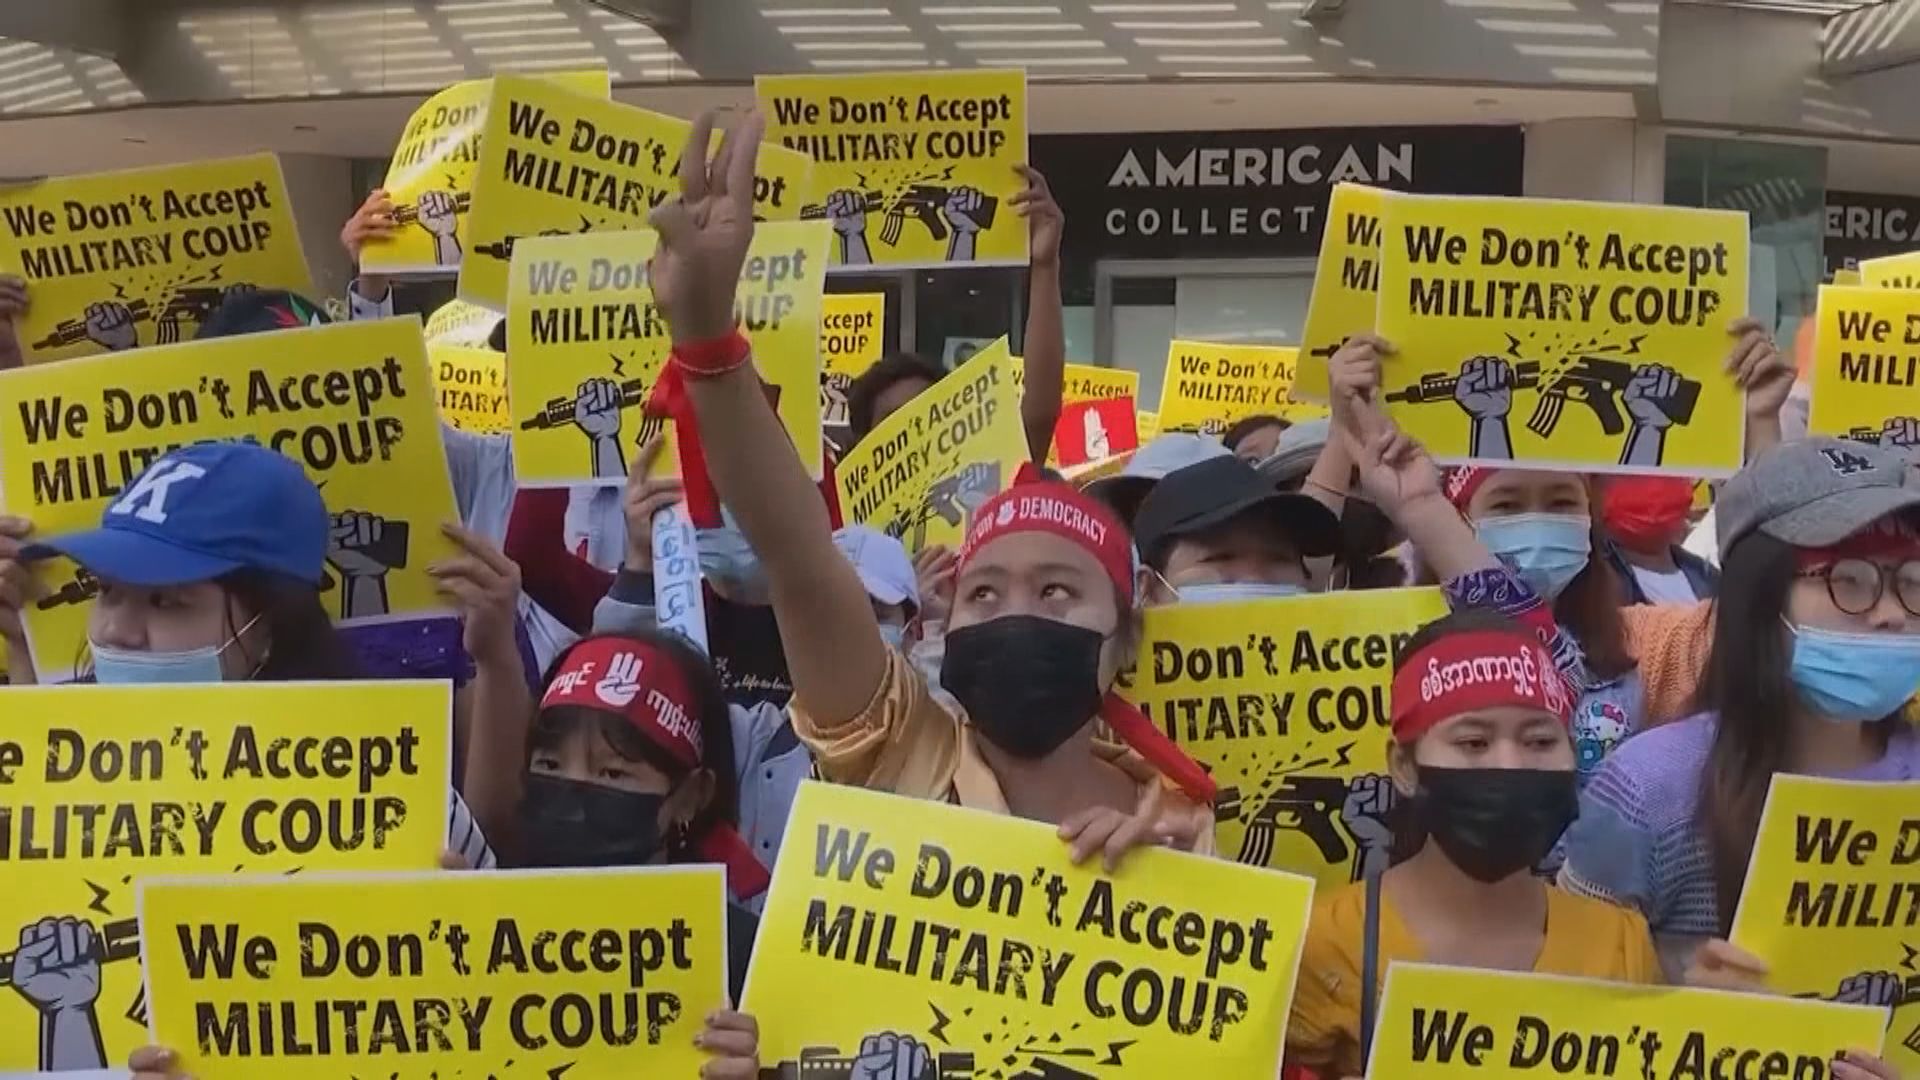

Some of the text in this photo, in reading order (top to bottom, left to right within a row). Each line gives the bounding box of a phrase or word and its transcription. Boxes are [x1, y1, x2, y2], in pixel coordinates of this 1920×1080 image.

[774, 93, 1011, 128] We Don't Accept
[508, 100, 667, 175] We Don't
[924, 129, 1006, 160] COUP
[1107, 143, 1414, 187] AMERICAN
[3, 180, 272, 239] We Don't Accept
[1346, 213, 1381, 247] W
[20, 220, 272, 281] MILITARY COUP
[1404, 224, 1728, 286] We Don't Accept
[527, 260, 578, 296] We
[1409, 277, 1721, 327] MILITARY COUP
[822, 311, 875, 335] ccept
[1838, 309, 1892, 344] We
[440, 360, 498, 388] Don't
[1179, 379, 1271, 406] MILITARY
[1180, 355, 1210, 376] We
[1216, 358, 1269, 380] Don't
[1839, 351, 1920, 388] MILI
[18, 356, 408, 444] We Don't Accept
[436, 389, 503, 415] ITARY
[844, 364, 1000, 500] We Don't Accept
[851, 398, 999, 526] MILITARY COUP
[111, 459, 207, 526] K
[1018, 496, 1108, 546] DEMOCRACY
[1152, 633, 1279, 685] Don't
[1140, 691, 1296, 744] ITARY
[44, 726, 209, 784] Don't
[222, 724, 420, 794] Accept
[240, 796, 408, 857] COUP
[1794, 813, 1878, 867] We
[812, 823, 1274, 980] We Don't Accept
[175, 917, 694, 989] We Don't Accept
[800, 898, 1250, 1044] MILITARY COUP
[194, 990, 684, 1058] MILITARY COUP
[1411, 1006, 1848, 1080] We Don't Accep
